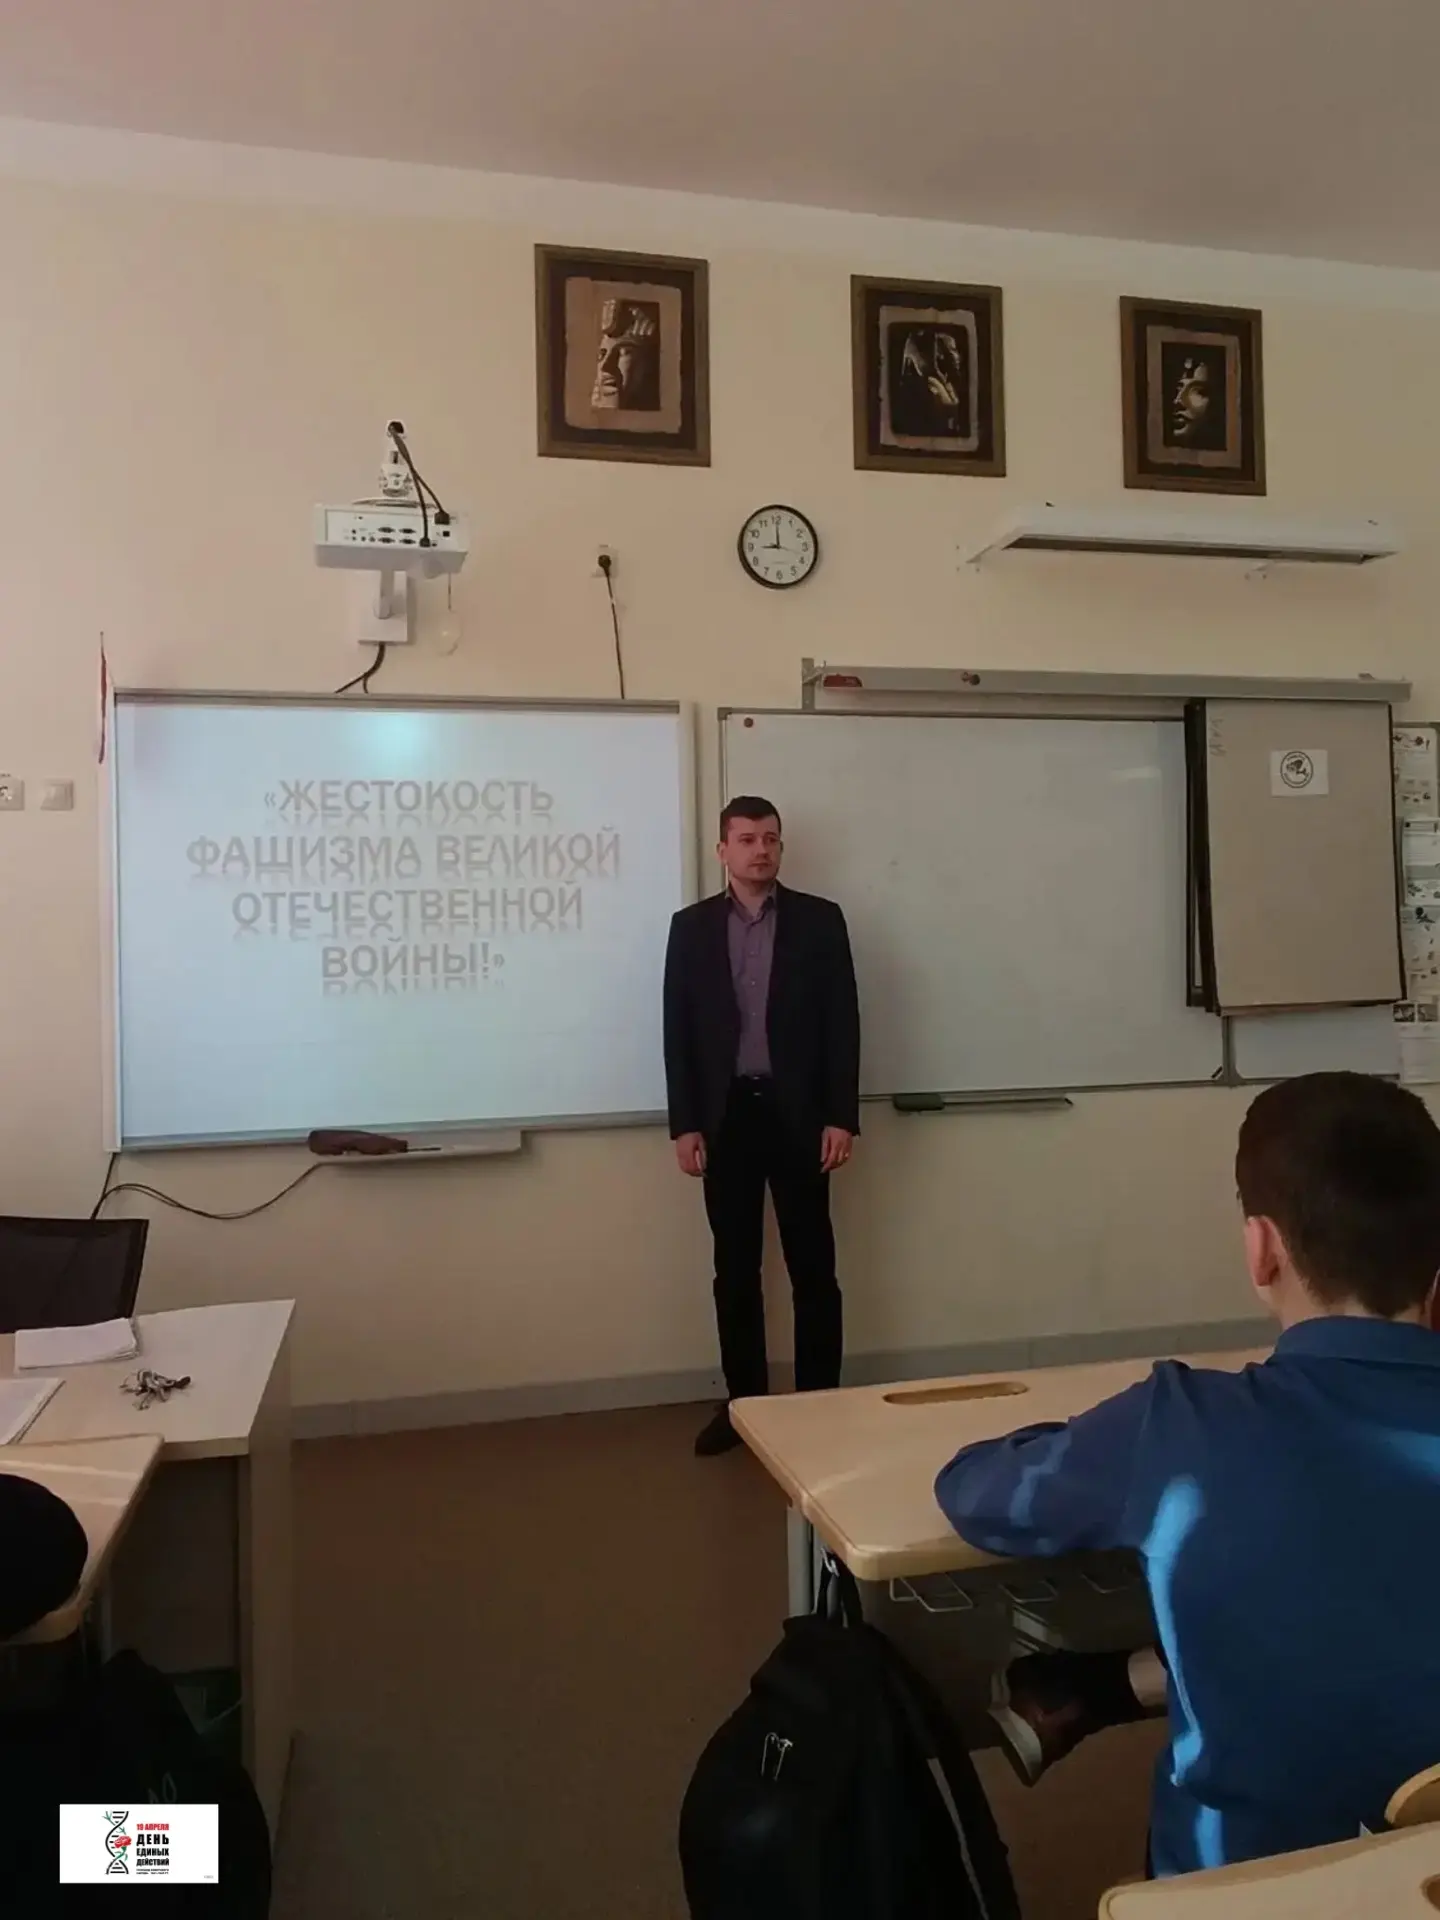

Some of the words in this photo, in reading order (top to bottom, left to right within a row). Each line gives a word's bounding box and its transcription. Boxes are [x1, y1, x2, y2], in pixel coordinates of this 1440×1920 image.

[264, 779, 554, 813] «ЖЕСТОКОСТЬ
[186, 835, 422, 870] ФАШИЗМА
[436, 824, 621, 869] ВЕЛИКОЙ
[231, 881, 583, 925] ОТЕЧЕСТВЕННОЙ
[321, 938, 505, 979] ВОЙНЫ!»
